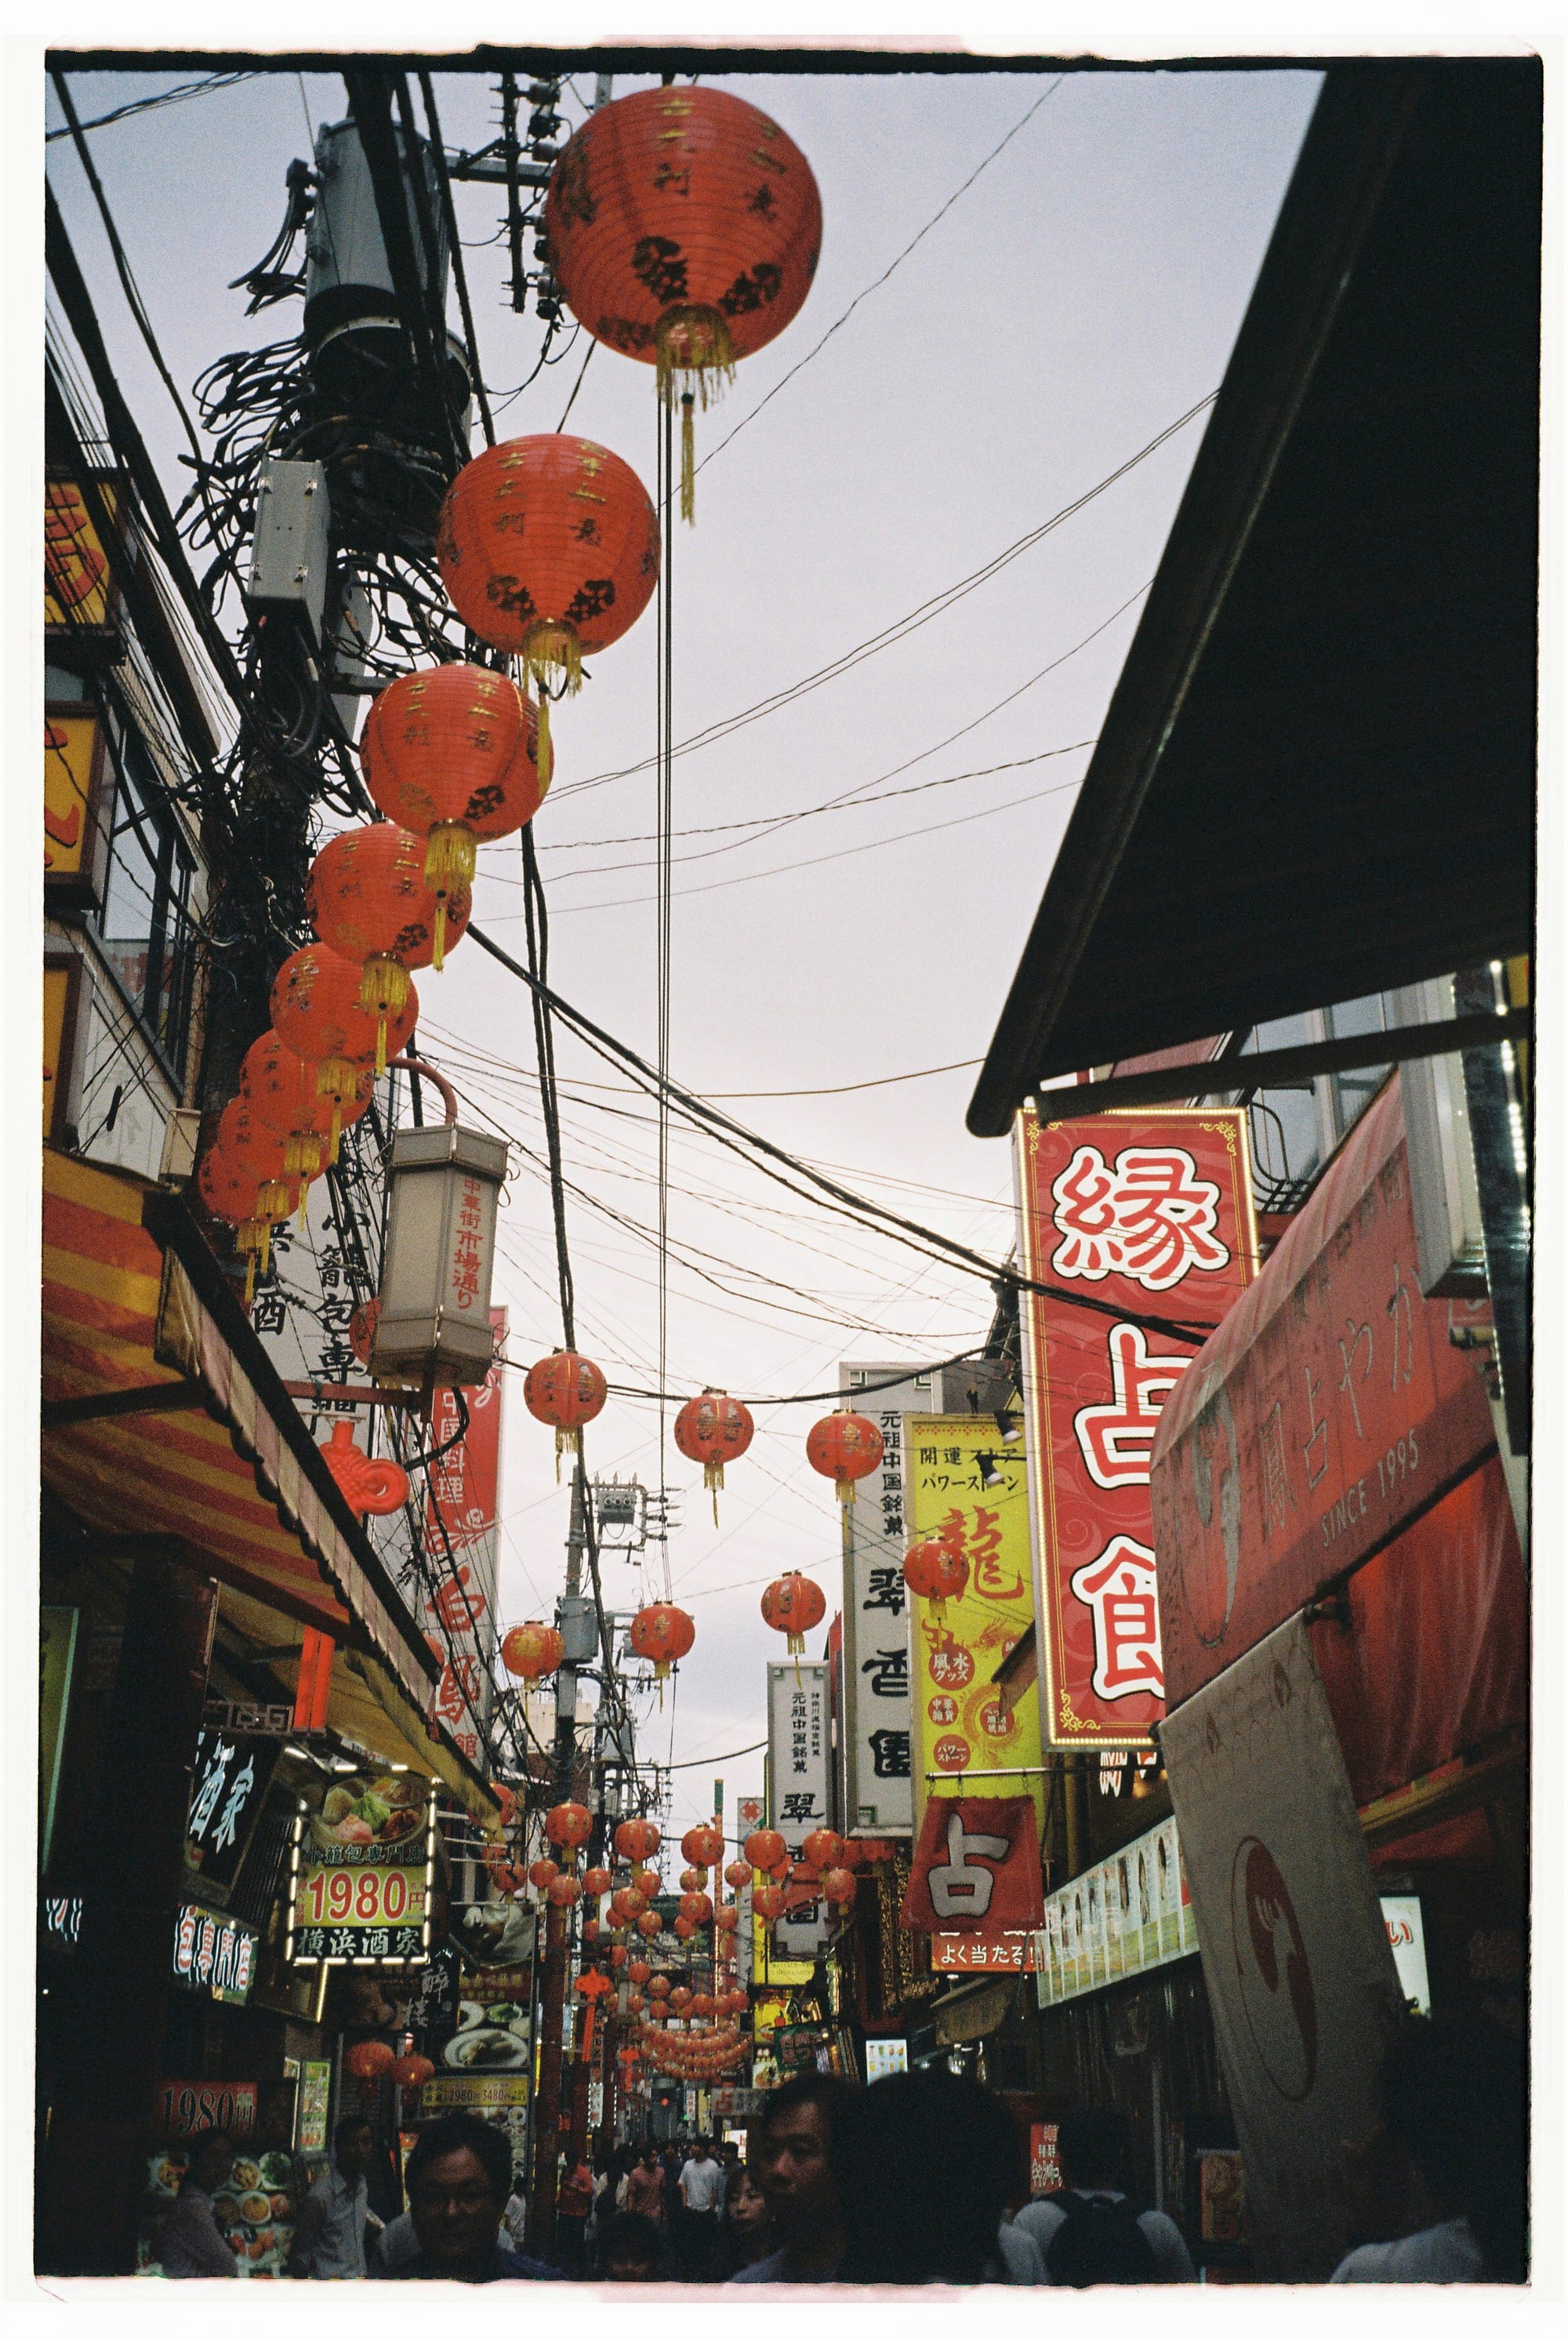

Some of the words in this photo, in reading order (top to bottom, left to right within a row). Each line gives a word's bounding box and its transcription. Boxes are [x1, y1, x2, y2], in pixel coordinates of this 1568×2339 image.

[452, 1178, 483, 1310] 中華街市場通り
[1321, 1478, 1368, 1549] SINCE
[1377, 1427, 1419, 1498] 1995
[933, 1652, 971, 1671] 風水
[937, 1743, 967, 1753] パワー
[937, 1753, 967, 1763] ストーン
[927, 1811, 1011, 1920] 占
[297, 1927, 420, 1957] 横浜酒家
[940, 1944, 1035, 1965] よく当たる!
